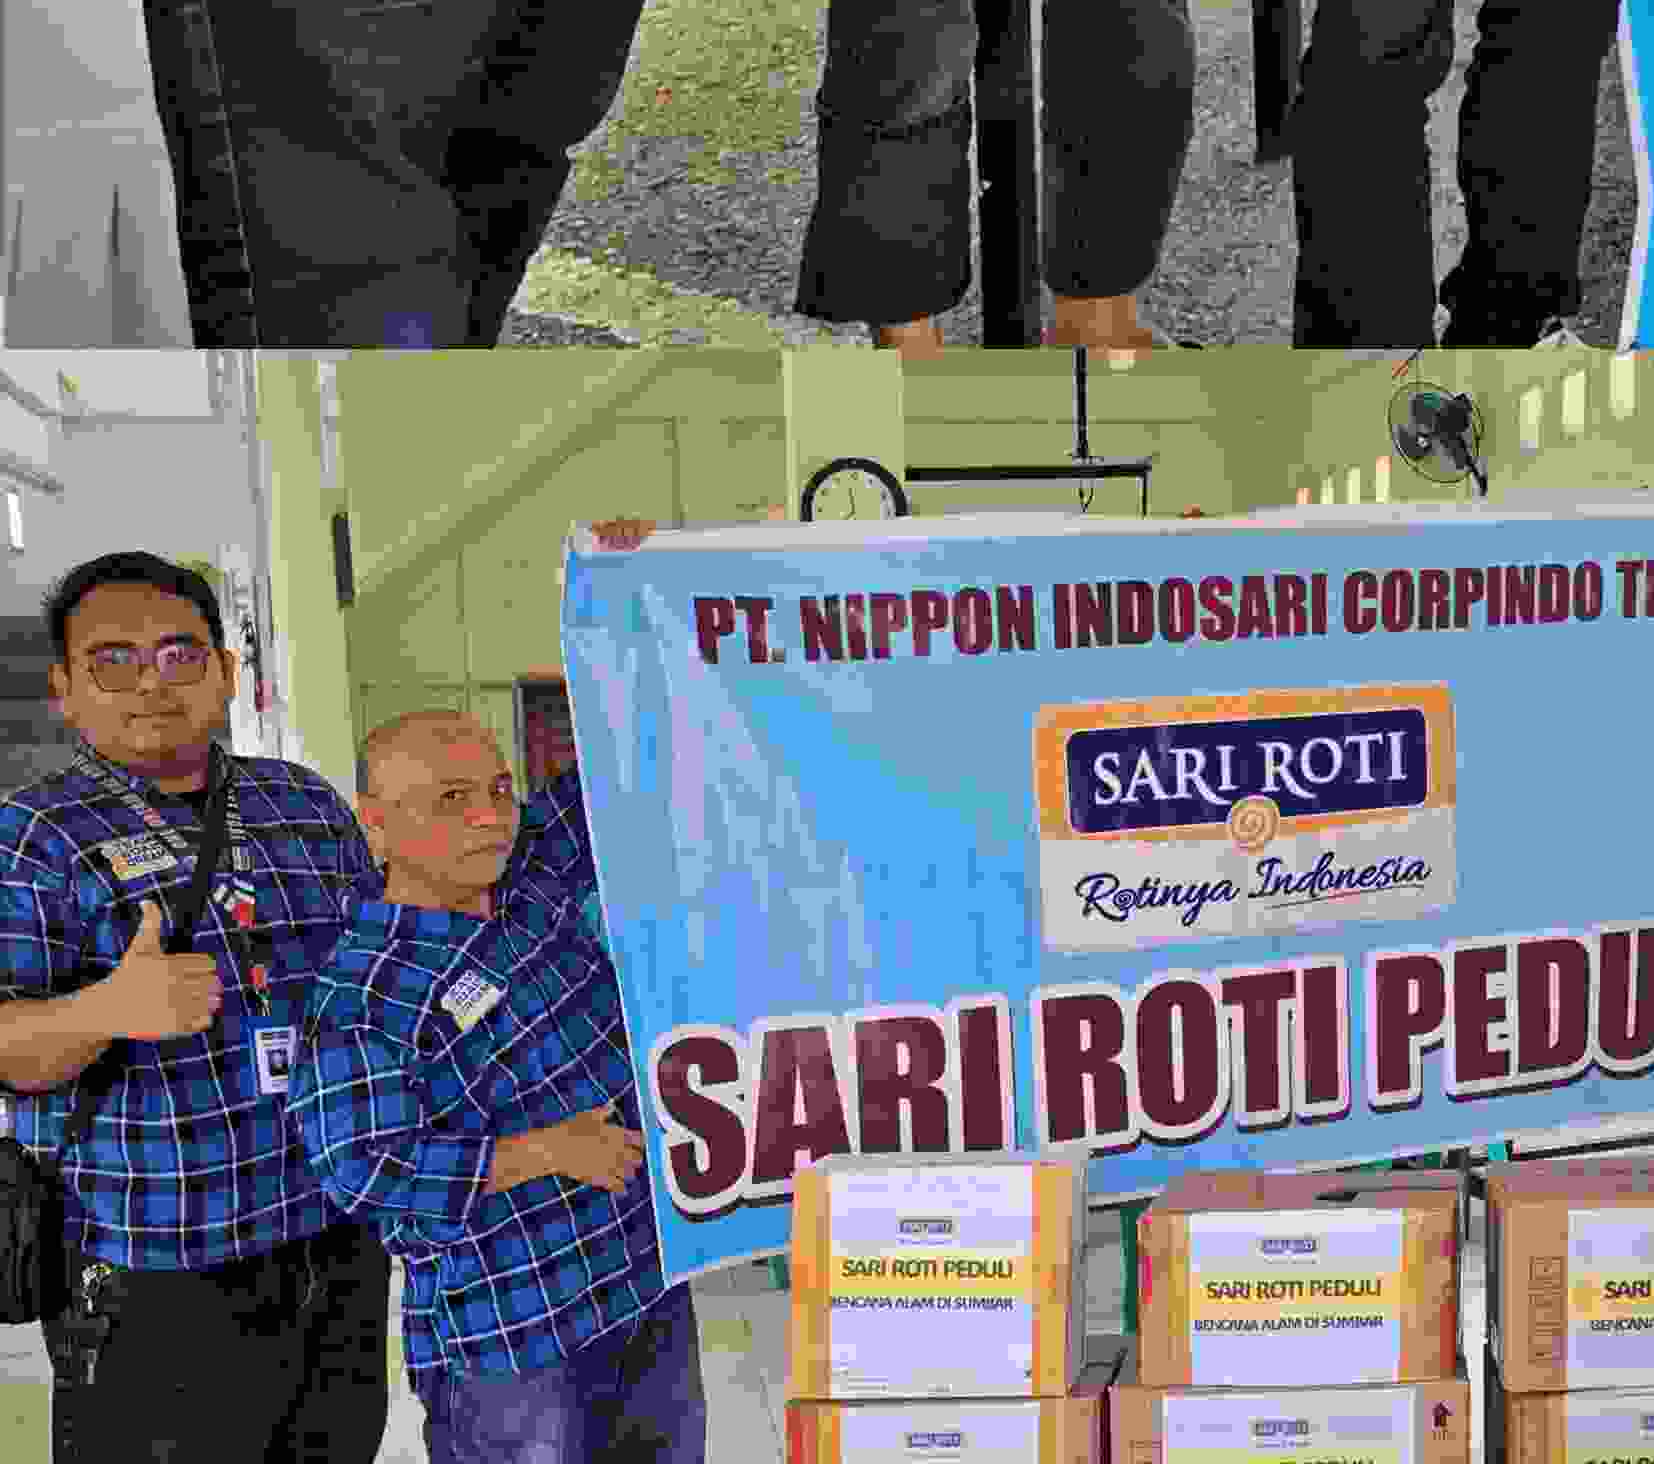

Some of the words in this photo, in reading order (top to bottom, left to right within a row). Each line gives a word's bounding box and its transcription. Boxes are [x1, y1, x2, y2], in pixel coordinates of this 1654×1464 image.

[695, 593, 788, 666] PT.
[799, 583, 1036, 664] NIPPON
[1052, 572, 1329, 653] INDOSARI
[1341, 561, 1602, 638] CORPINDO
[1092, 741, 1233, 808] SARI
[1260, 731, 1410, 800] ROTI
[1074, 869, 1242, 929] Rotinya
[1247, 852, 1433, 904] Indonesia
[652, 988, 1010, 1208] SARI
[1040, 964, 1347, 1148] ROTI
[842, 1258, 886, 1279] SARI
[893, 1258, 937, 1279] ROTI
[945, 1258, 1013, 1279] PEDULI
[1207, 1281, 1249, 1299] SARI
[1256, 1280, 1304, 1299] ROTI
[1310, 1279, 1381, 1297] PEDULI
[1604, 1278, 1651, 1299] SARI
